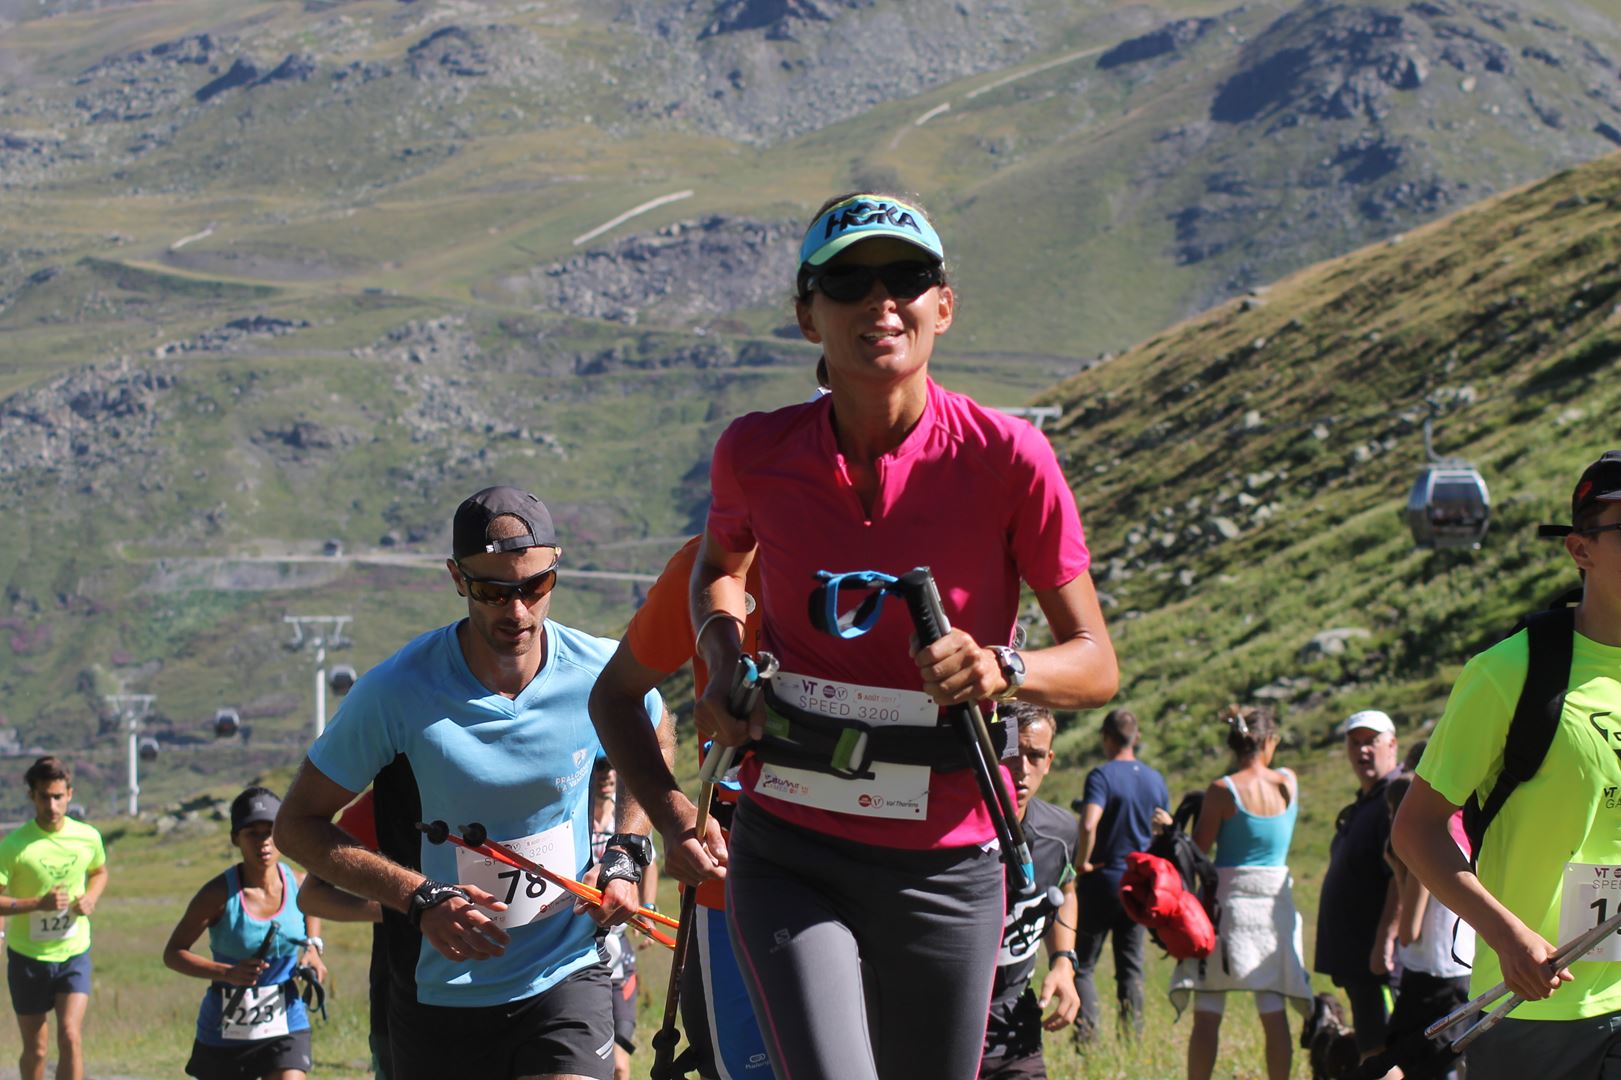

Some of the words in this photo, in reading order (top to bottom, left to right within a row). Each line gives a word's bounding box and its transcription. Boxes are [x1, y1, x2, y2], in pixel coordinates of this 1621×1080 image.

[825, 202, 922, 240] HOKA
[801, 679, 818, 696] VT
[800, 695, 850, 716] SPEED
[857, 706, 899, 722] 3200
[1603, 786, 1618, 798] VT
[529, 840, 555, 858] 3200
[1594, 867, 1610, 879] VT
[497, 863, 547, 904] 78
[40, 915, 72, 932] 122
[235, 1004, 274, 1026] 223
